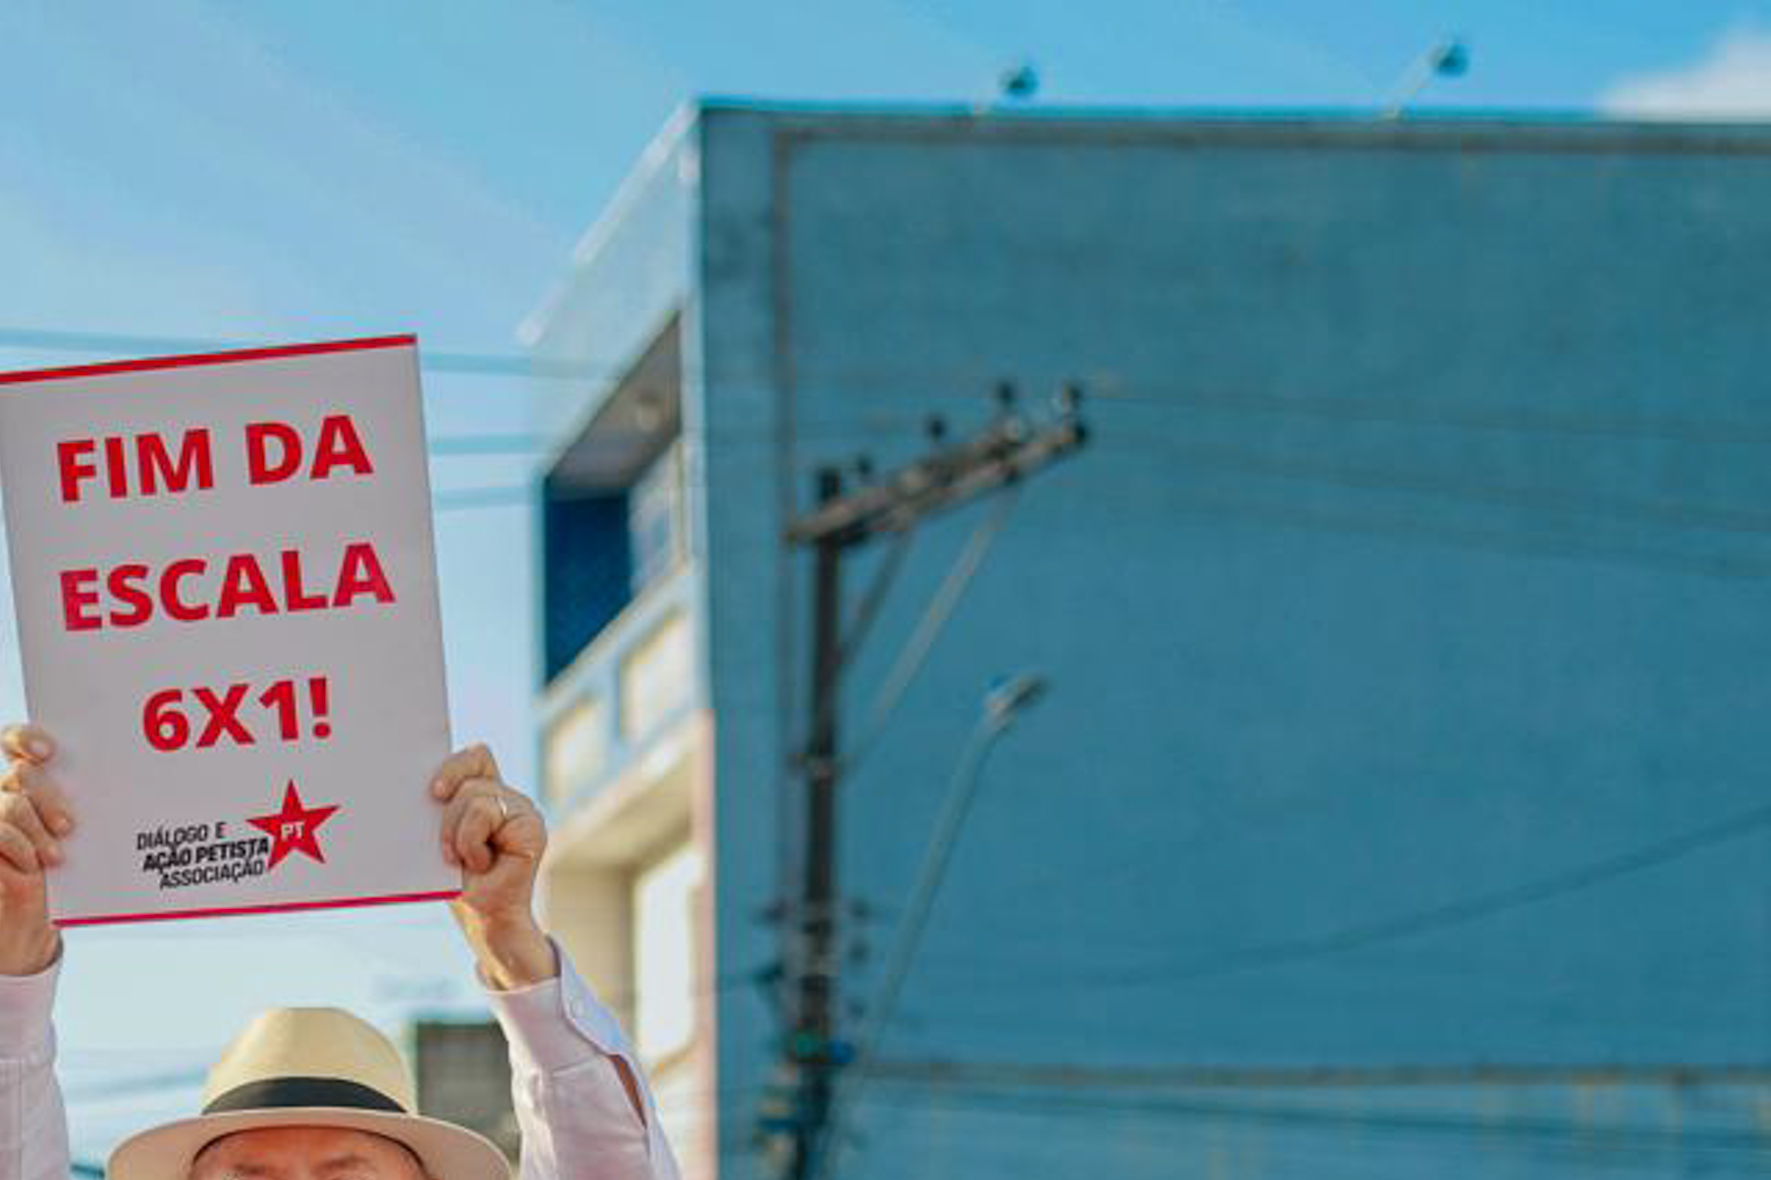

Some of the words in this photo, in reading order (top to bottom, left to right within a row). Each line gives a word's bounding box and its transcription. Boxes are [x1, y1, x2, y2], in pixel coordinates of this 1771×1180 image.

[57, 428, 214, 503] FIM
[245, 414, 373, 486] DA
[59, 542, 396, 631] ESCALA
[142, 677, 331, 751] 6X1!
[137, 823, 208, 850] DIÁLOGO
[215, 821, 227, 838] E
[281, 821, 306, 840] PT
[143, 844, 191, 874] AÇÃO
[195, 837, 269, 864] PETISTA
[160, 859, 264, 890] ASSOCIAÇÃO
